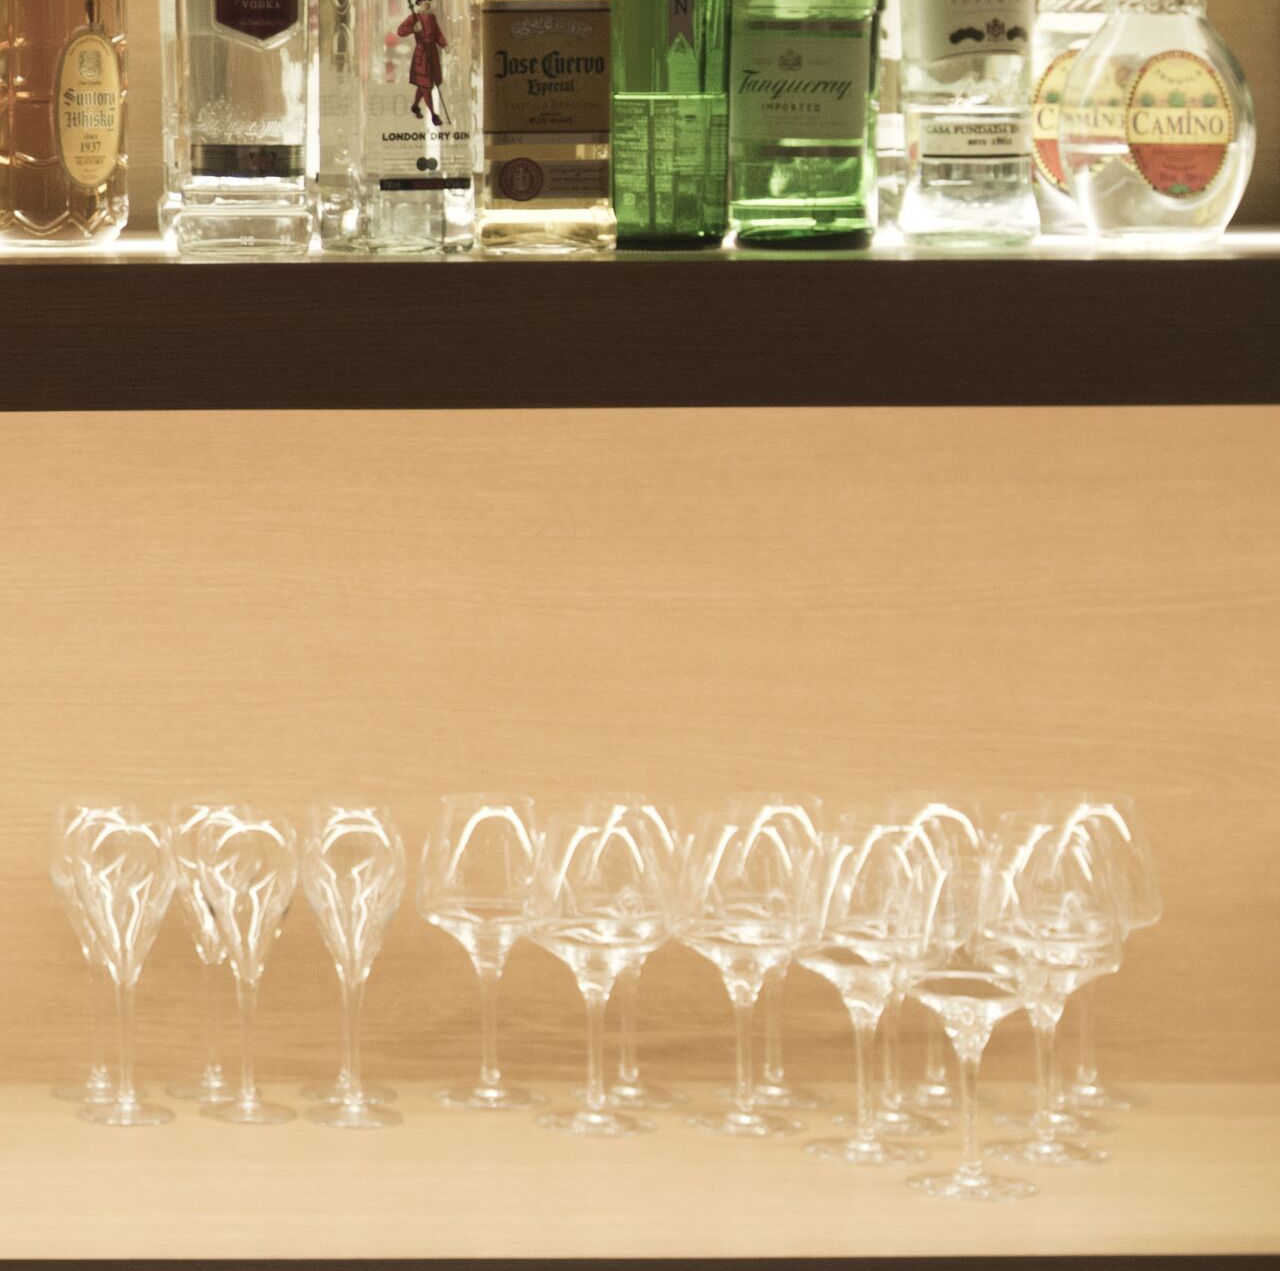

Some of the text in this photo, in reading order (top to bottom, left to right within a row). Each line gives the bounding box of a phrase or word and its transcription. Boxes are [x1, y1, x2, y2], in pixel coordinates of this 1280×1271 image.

[241, 0, 291, 10] VODKA
[495, 50, 605, 78] Jose Cuervo
[527, 79, 575, 96] Especial
[740, 70, 853, 100] Tanqueray
[63, 88, 116, 111] Suntory
[761, 102, 822, 112] IMPORTED
[64, 110, 115, 132] Whisky
[382, 132, 470, 141] LONDON DRY GIN
[80, 141, 102, 153] 1937
